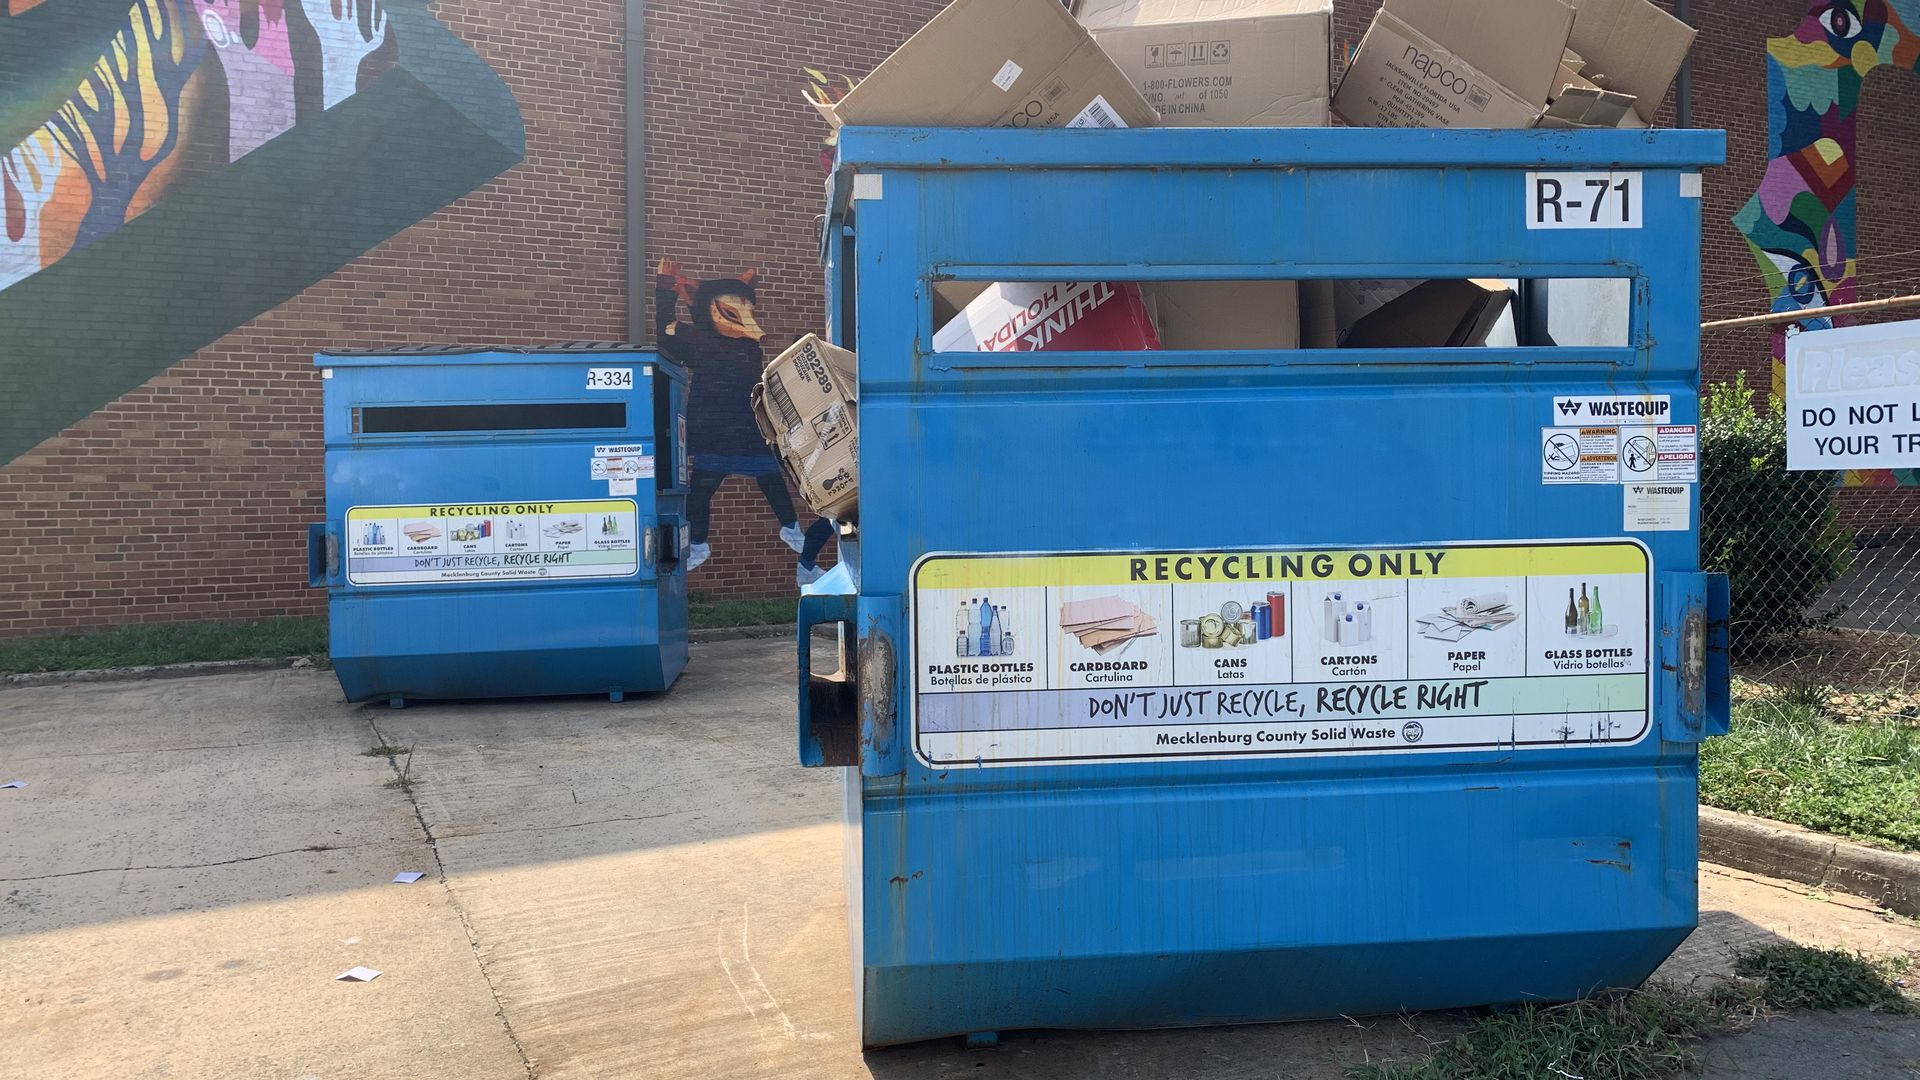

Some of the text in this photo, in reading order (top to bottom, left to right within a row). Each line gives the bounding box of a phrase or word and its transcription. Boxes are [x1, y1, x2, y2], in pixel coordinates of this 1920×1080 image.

[1402, 45, 1467, 95] napco
[1143, 76, 1232, 90] 1-800-FLOWERS.COM
[1397, 79, 1412, 91] ITEM
[1199, 89, 1207, 100] of
[1210, 89, 1229, 100] 1050
[1168, 104, 1177, 114] IN
[1178, 103, 1206, 114] CHINA
[1387, 81, 1403, 95] CLEAR
[1404, 93, 1435, 116] GATHERING
[1435, 113, 1450, 126] VASE
[1448, 101, 1460, 113] USA
[1537, 179, 1630, 222] R-71
[977, 285, 1060, 352] HOLIDA
[1024, 282, 1115, 352] THINK
[803, 342, 833, 393] 982289
[587, 371, 631, 386] R-334
[1589, 401, 1668, 417] WASTEQUIP
[1802, 407, 1836, 427] DO
[1849, 403, 1898, 425] NOT
[1814, 435, 1879, 456] YOUR
[430, 504, 554, 517] RECYCLING ONLY
[415, 557, 441, 567] DON'T
[442, 556, 462, 567] JUST
[504, 554, 540, 565] RECYCLE
[544, 552, 572, 564] RIGHT
[1130, 552, 1446, 581] RECYCLING ONLY
[1320, 655, 1378, 666] CARTONS
[1447, 651, 1486, 661] PAPER
[1544, 648, 1633, 660] GLASS BOTTLES
[928, 662, 1034, 674] PLASTIC BOTTLES
[1069, 661, 1148, 672] CARDBOARD
[1213, 658, 1248, 668] CANS
[1452, 661, 1481, 673] Papel
[1553, 658, 1624, 671] Vidrio botellas
[1085, 672, 1133, 683] Cartulina
[1217, 669, 1245, 680] Latas
[1331, 665, 1367, 677] Cartón
[930, 673, 1032, 686] Botellas de plástico
[1089, 681, 1488, 720] DON'T JUST RECYCLE, RECYCLE RIGHT
[1156, 731, 1252, 746] Mecklenburg
[1256, 729, 1307, 745] County
[1311, 727, 1347, 741] Solid
[1350, 727, 1396, 741] Waste
